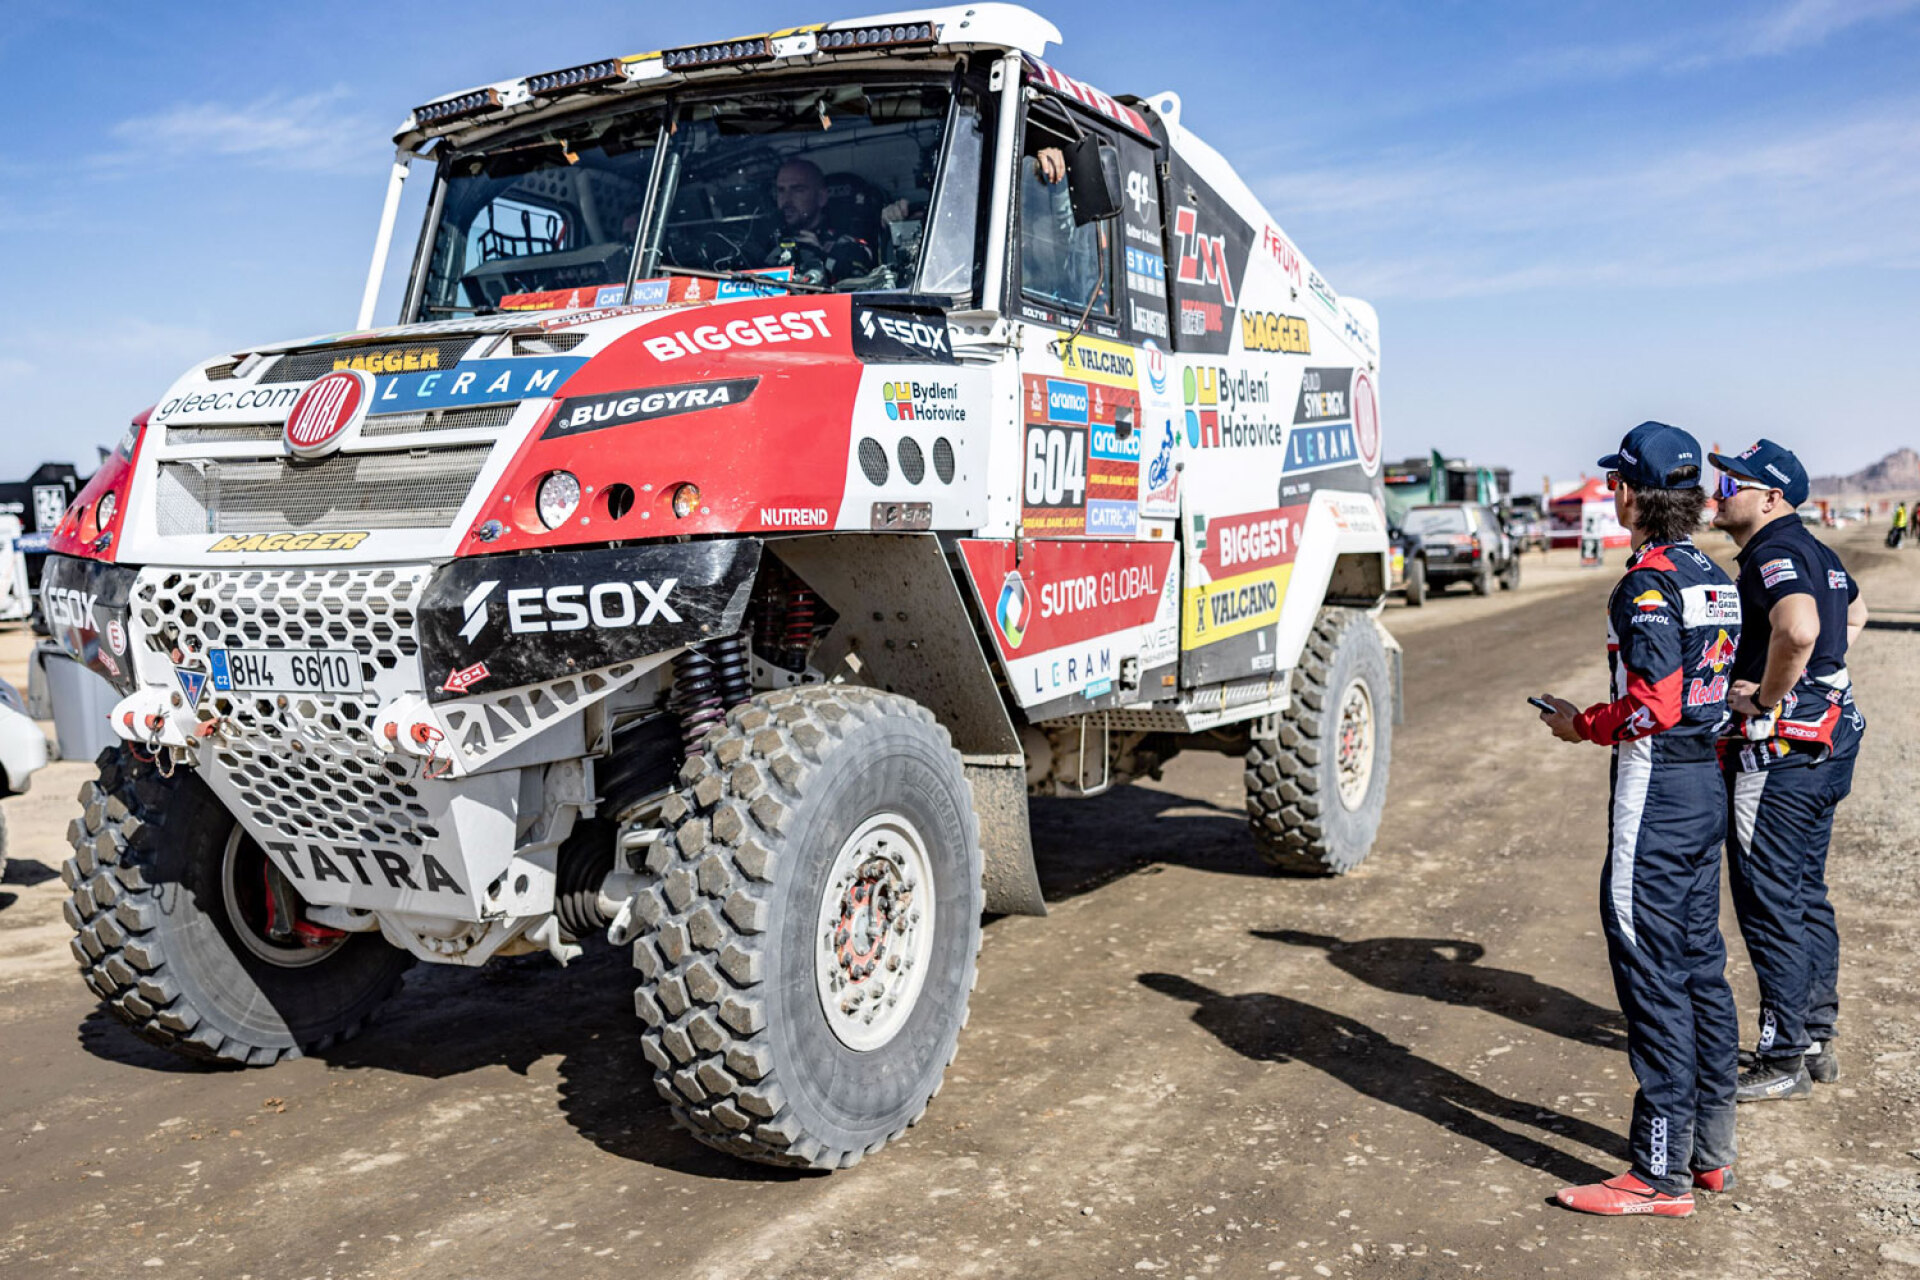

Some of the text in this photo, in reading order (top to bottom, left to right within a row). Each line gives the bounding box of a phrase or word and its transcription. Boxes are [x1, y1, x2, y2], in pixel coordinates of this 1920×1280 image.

[643, 309, 832, 362] BIGGEST
[878, 317, 948, 353] ESOX
[1240, 309, 1311, 355] BAGGER
[1077, 347, 1134, 377] VALCANO
[156, 386, 301, 422] gleec.com
[382, 369, 560, 400] LERAM
[912, 381, 957, 404] Bydlení
[1050, 392, 1086, 412] aramco
[1218, 367, 1269, 412] Bydlení
[292, 376, 353, 442] TATRA
[570, 386, 730, 428] BUGGYRA
[912, 404, 966, 422] Hořovice
[1221, 414, 1282, 448] Hořovice
[1293, 429, 1352, 465] LERAM
[1025, 428, 1086, 505] 604
[760, 508, 828, 527] NUTREND
[1091, 506, 1136, 530] CATRION
[1219, 517, 1289, 567] BIGGEST
[48, 586, 100, 633] ESOX
[506, 578, 682, 634] ESOX
[1041, 576, 1097, 618] SUTOR
[1100, 565, 1158, 605] GLOBAL
[1211, 581, 1277, 626] VALCANO
[1631, 613, 1670, 625] REPSOL
[216, 676, 229, 686] CZ
[232, 655, 351, 688] 8H4 6610
[1034, 648, 1111, 693] LERAM
[265, 841, 466, 896] TATRA
[1650, 1116, 1668, 1177] sparco
